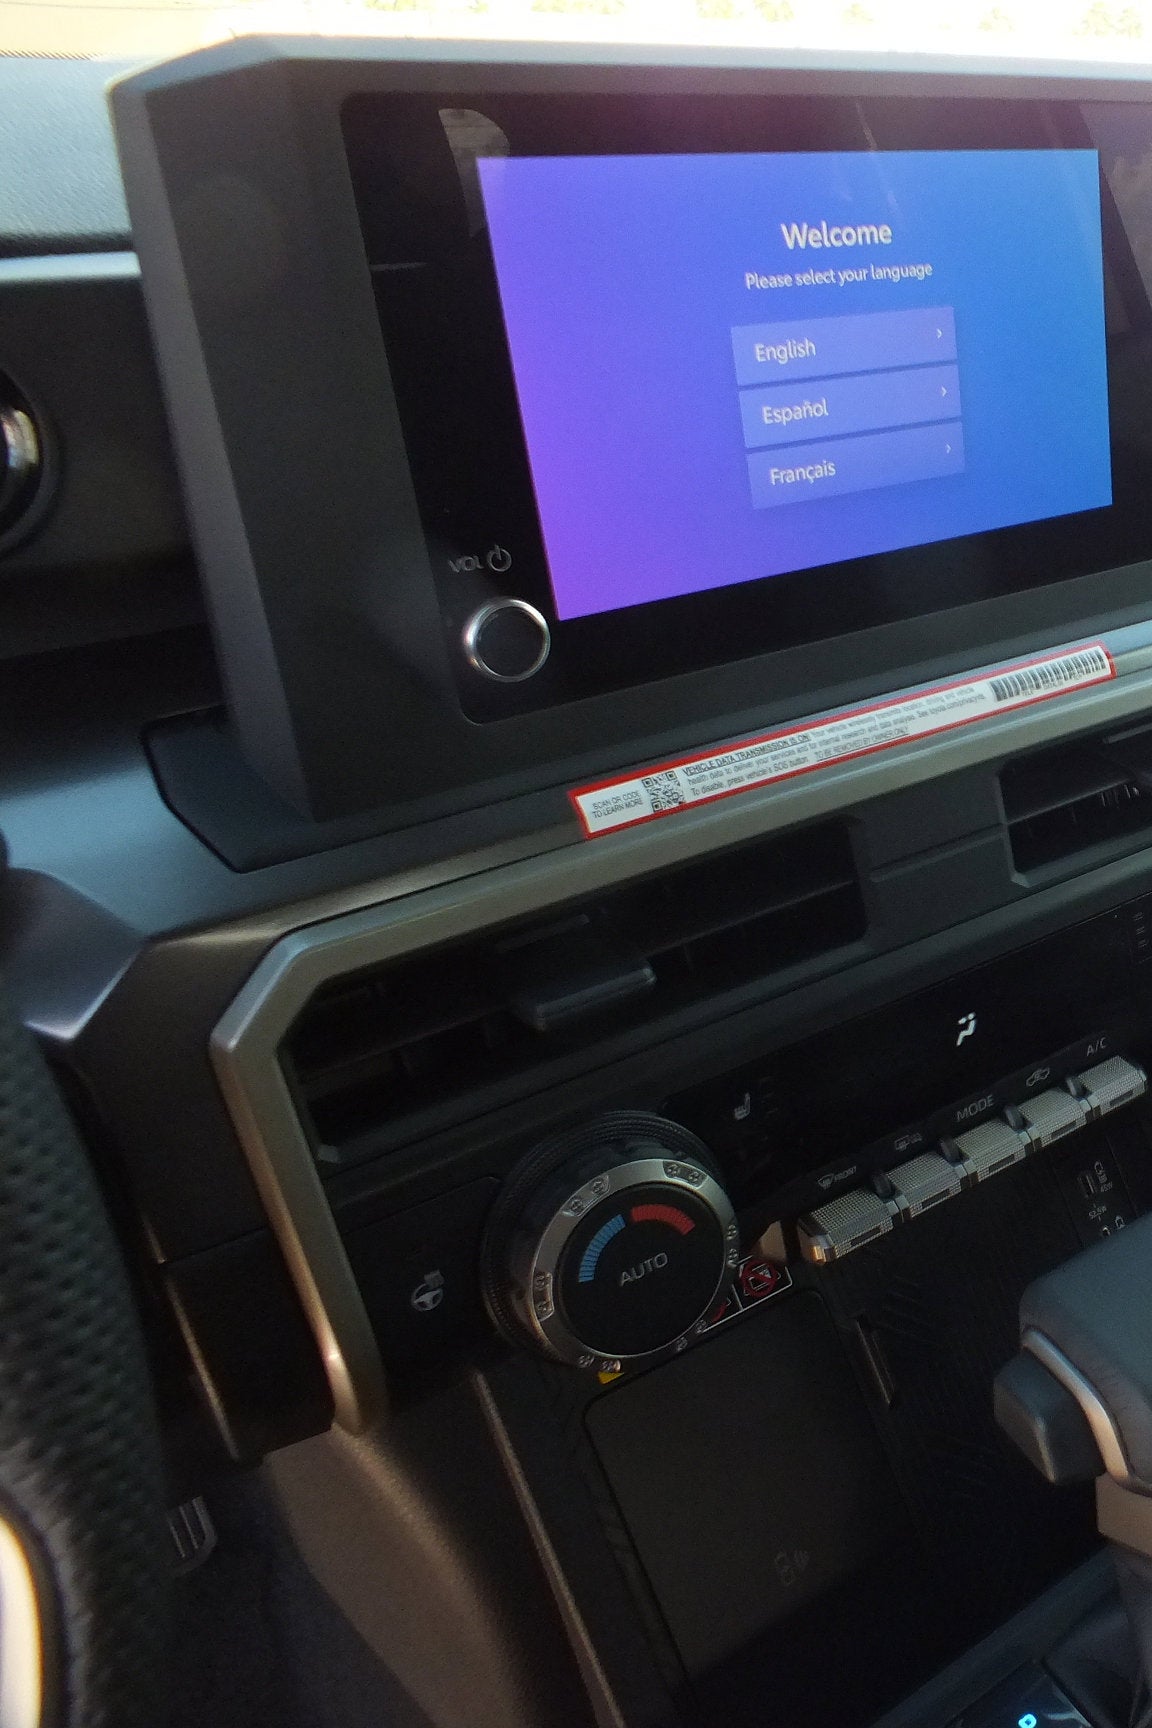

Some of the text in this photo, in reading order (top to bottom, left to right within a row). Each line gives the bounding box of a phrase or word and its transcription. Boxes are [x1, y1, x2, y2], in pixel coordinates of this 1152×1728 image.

[780, 220, 893, 250] Welcome
[745, 262, 933, 289] Please select your language
[754, 337, 816, 364] English
[761, 398, 829, 426] Español
[769, 459, 836, 486] Français
[448, 555, 485, 573] VOL
[682, 760, 716, 776] VEHICLE
[715, 755, 736, 768] DATA
[736, 739, 790, 761] TRANSMISSION
[592, 799, 612, 811] SCAN
[622, 790, 641, 801] CODE
[690, 786, 701, 798] To
[592, 810, 603, 819] TO
[603, 803, 625, 817] LEARN
[1086, 1036, 1107, 1057] A/C
[956, 1094, 995, 1123] MODE
[619, 1252, 669, 1287] AUTO
